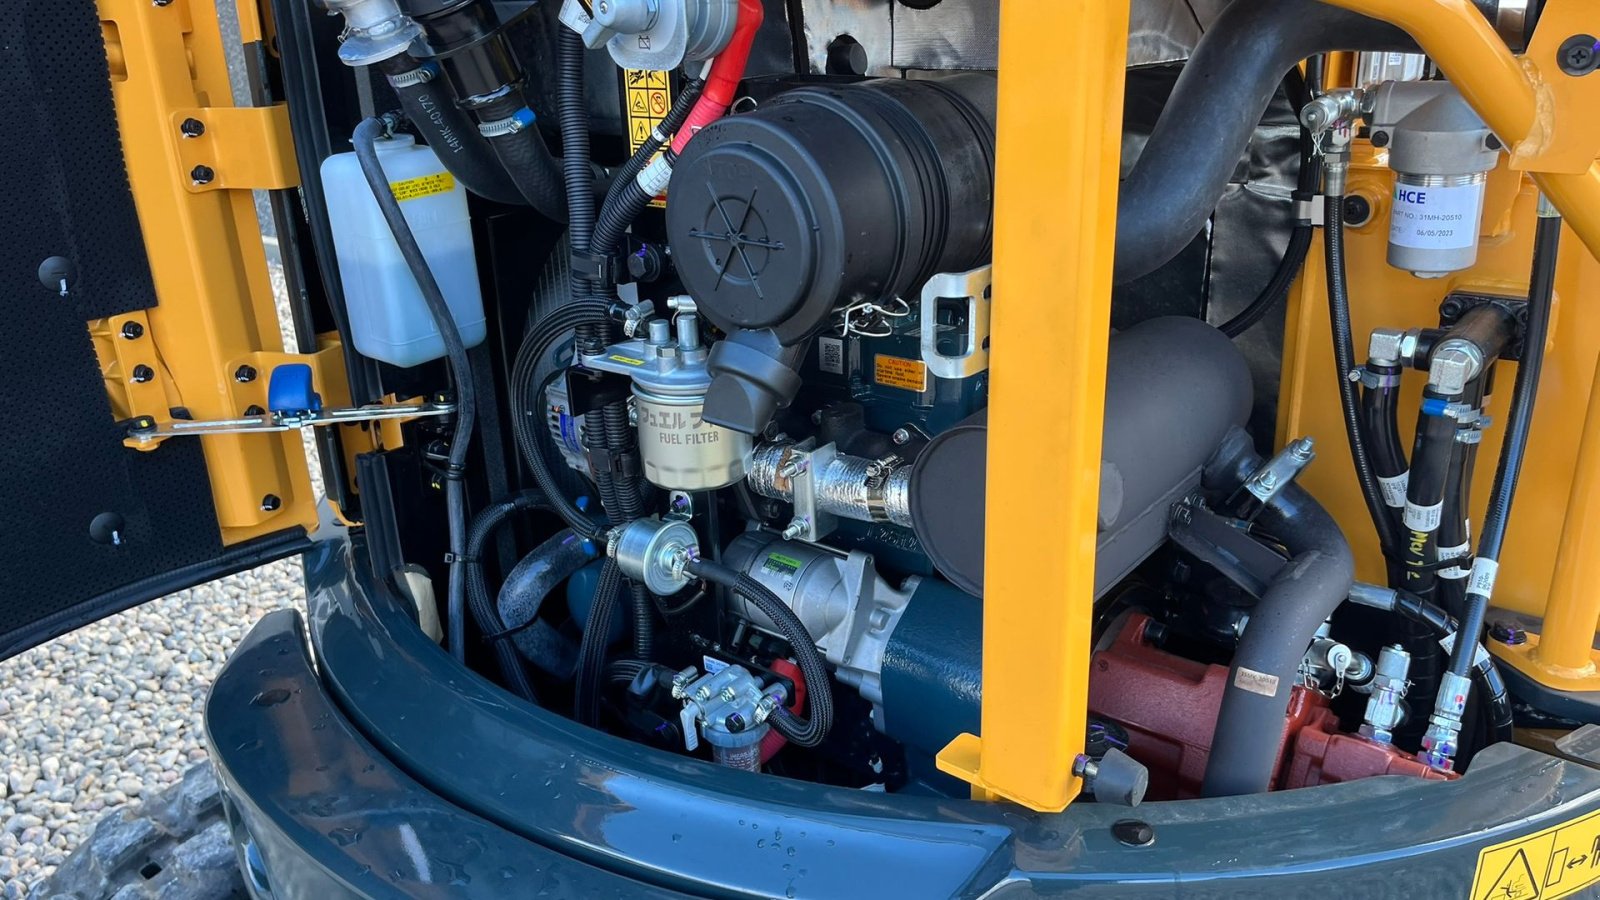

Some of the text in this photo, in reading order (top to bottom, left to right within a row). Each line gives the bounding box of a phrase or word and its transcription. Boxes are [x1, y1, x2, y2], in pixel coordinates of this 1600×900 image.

[419, 94, 464, 153] 14MK-40170
[1398, 189, 1426, 204] HCE
[888, 358, 912, 367] CAUTION
[660, 430, 719, 445] FUEL FILTER
